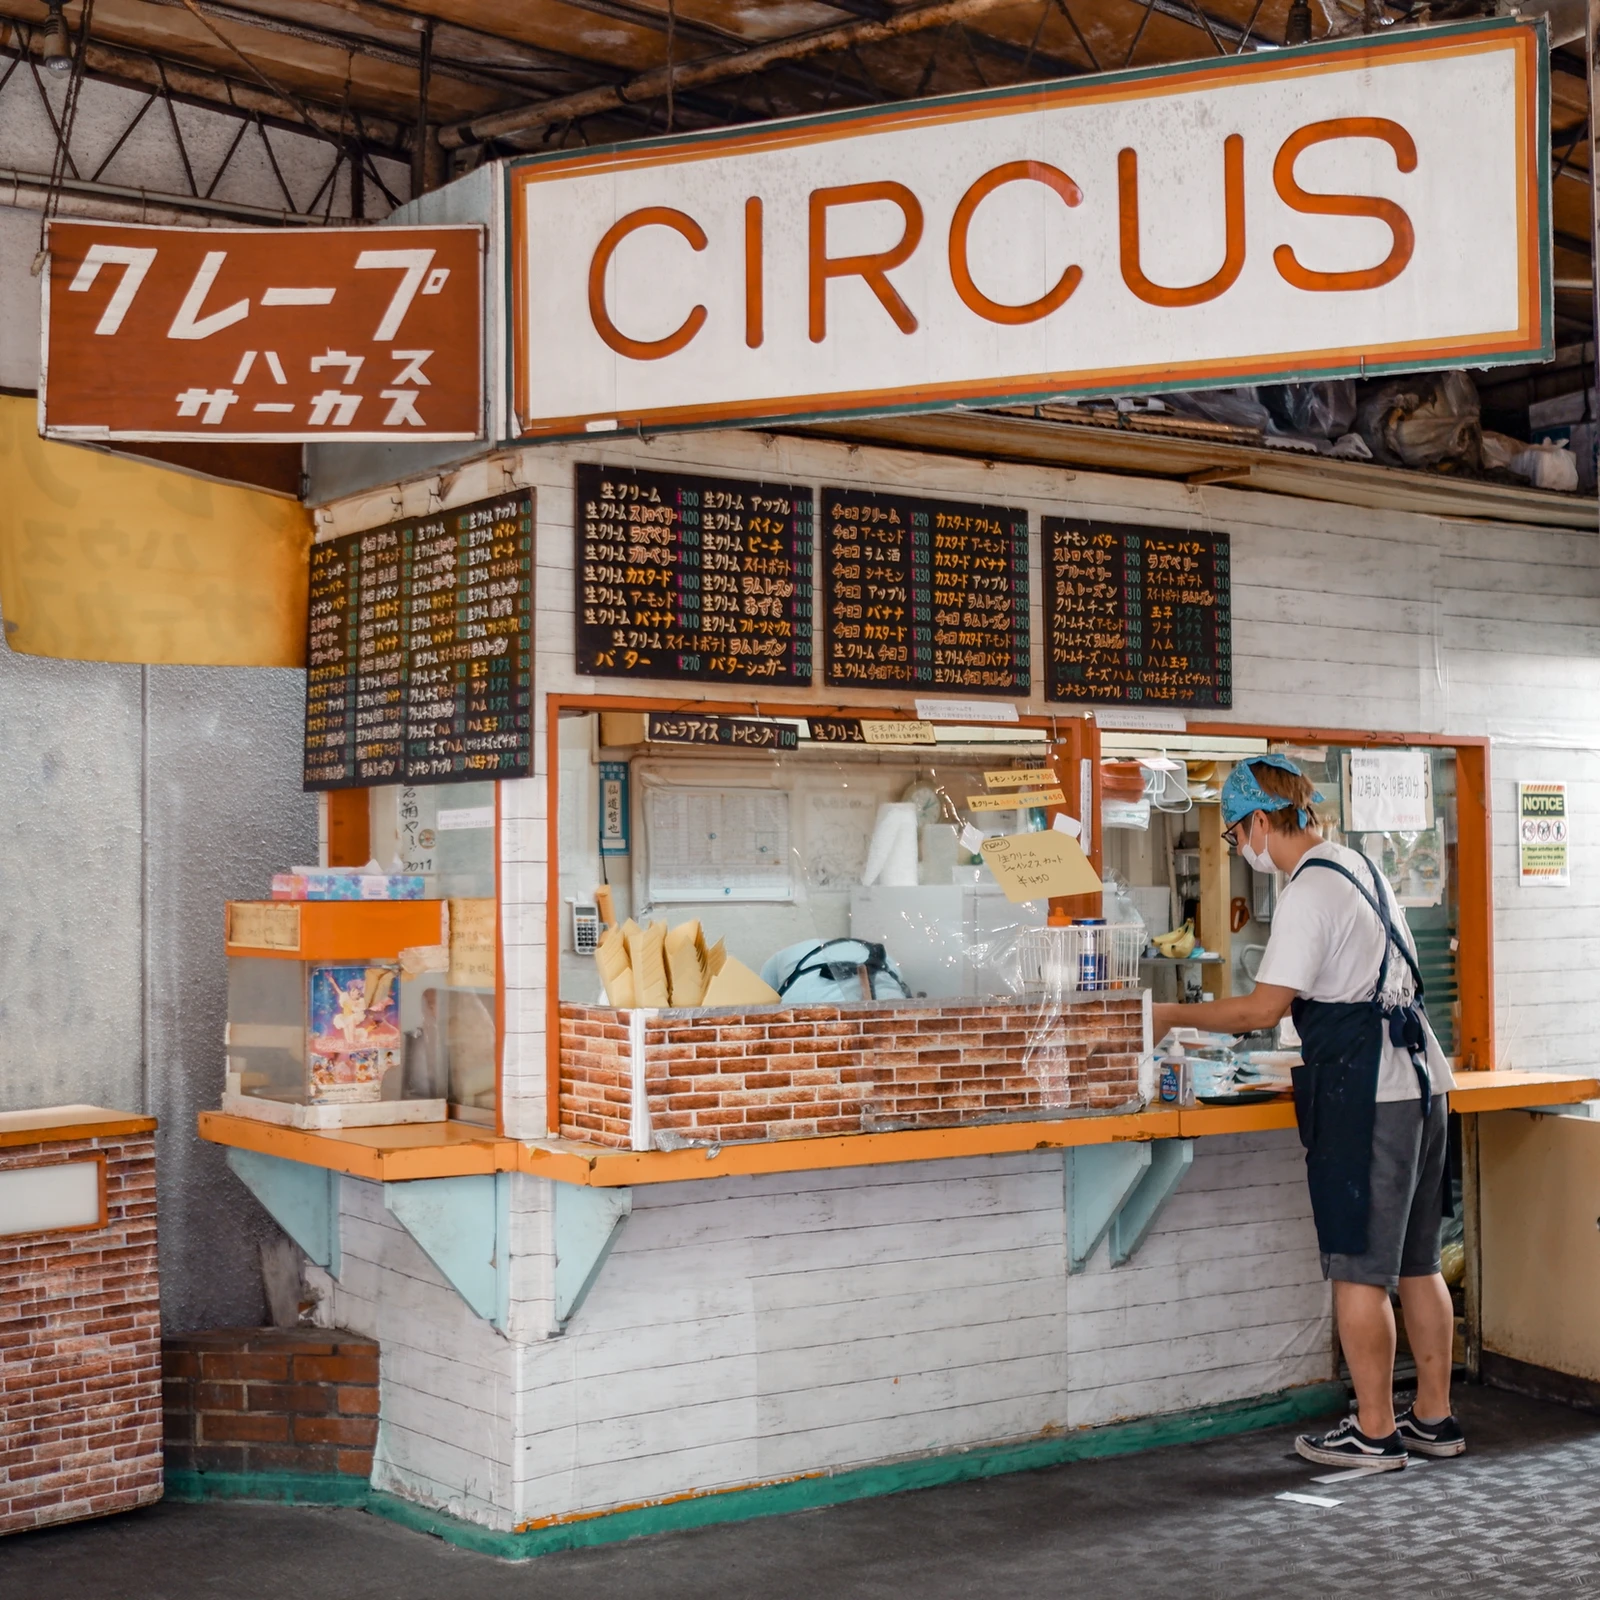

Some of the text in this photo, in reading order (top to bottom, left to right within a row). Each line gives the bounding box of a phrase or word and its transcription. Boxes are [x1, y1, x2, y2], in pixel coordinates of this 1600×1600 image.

[587, 116, 1418, 361] CIRCUS
[69, 243, 450, 342] クレープ
[232, 347, 431, 386] ハウス
[176, 387, 426, 427] サーカス
[814, 723, 863, 742] 生クリーム
[1524, 796, 1564, 811] NOTICE
